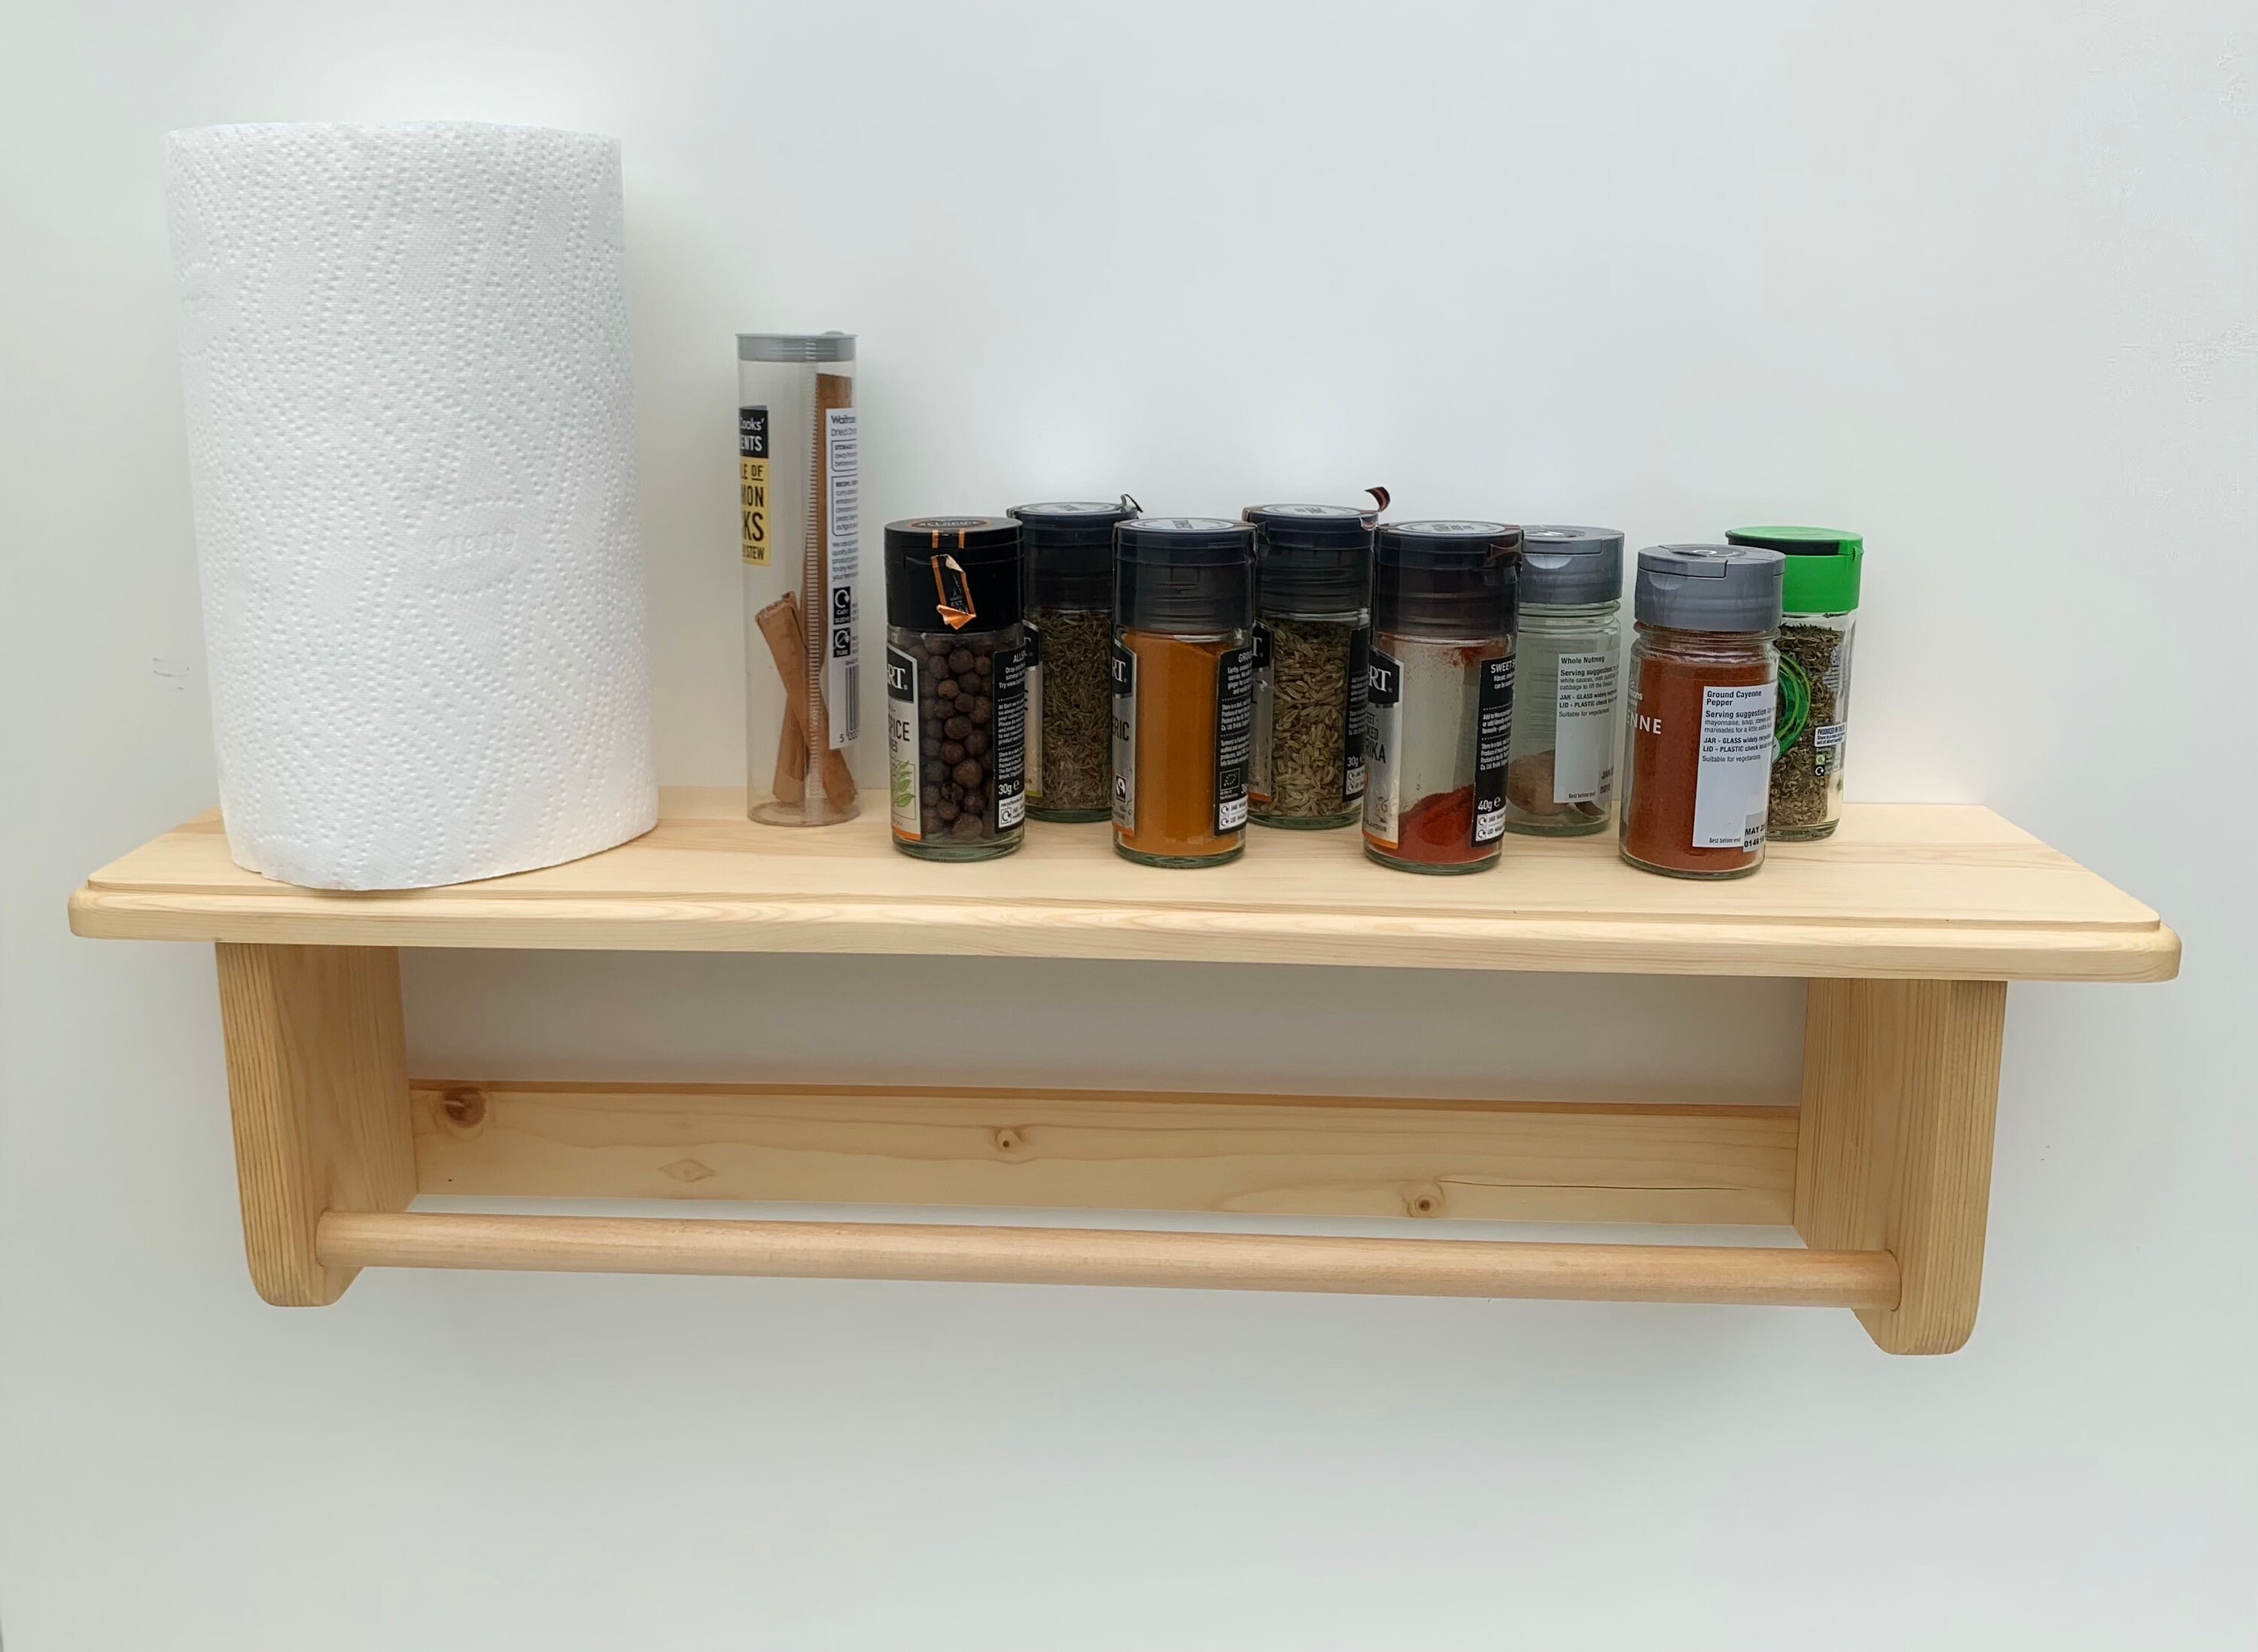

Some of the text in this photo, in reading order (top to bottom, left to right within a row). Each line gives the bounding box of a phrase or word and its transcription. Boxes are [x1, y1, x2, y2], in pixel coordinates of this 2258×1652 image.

[751, 464, 764, 477] OF
[1587, 666, 1612, 676] suggestion
[1707, 690, 1762, 698] Ground Cayenne
[1706, 698, 1733, 707] Pepper
[1706, 710, 1734, 719] Serving
[1736, 709, 1767, 719] suggestion
[1736, 754, 1760, 762] vegetarians
[998, 783, 1012, 795] 30g
[1477, 799, 1493, 811] 40g
[1745, 825, 1760, 836] MAY
